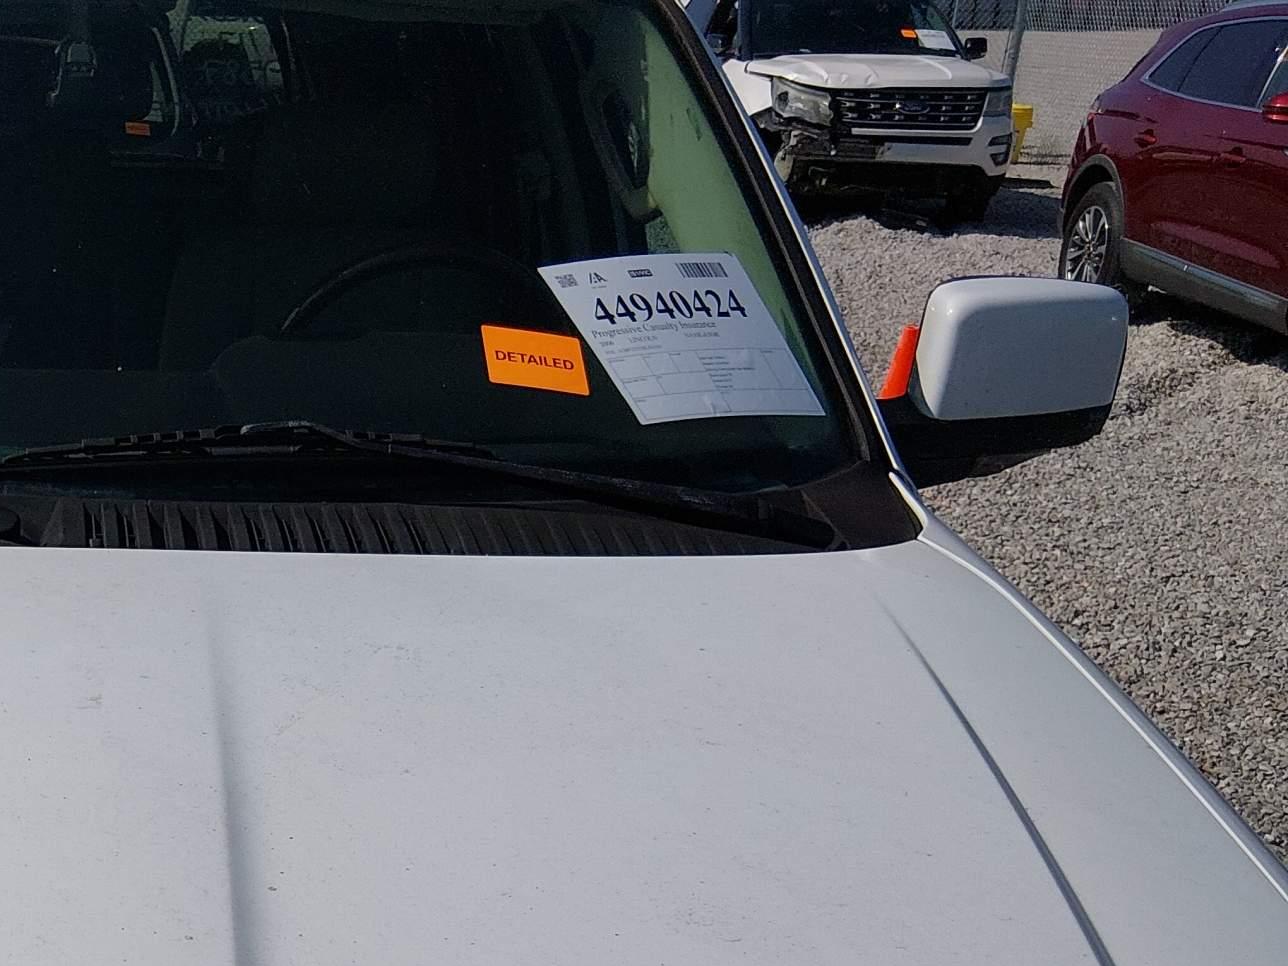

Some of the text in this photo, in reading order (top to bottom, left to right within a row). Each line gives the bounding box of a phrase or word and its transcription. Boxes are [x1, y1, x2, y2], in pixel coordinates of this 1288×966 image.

[594, 289, 749, 325] 44940424
[591, 326, 643, 339] Progressive
[495, 350, 575, 371] DETAILED
